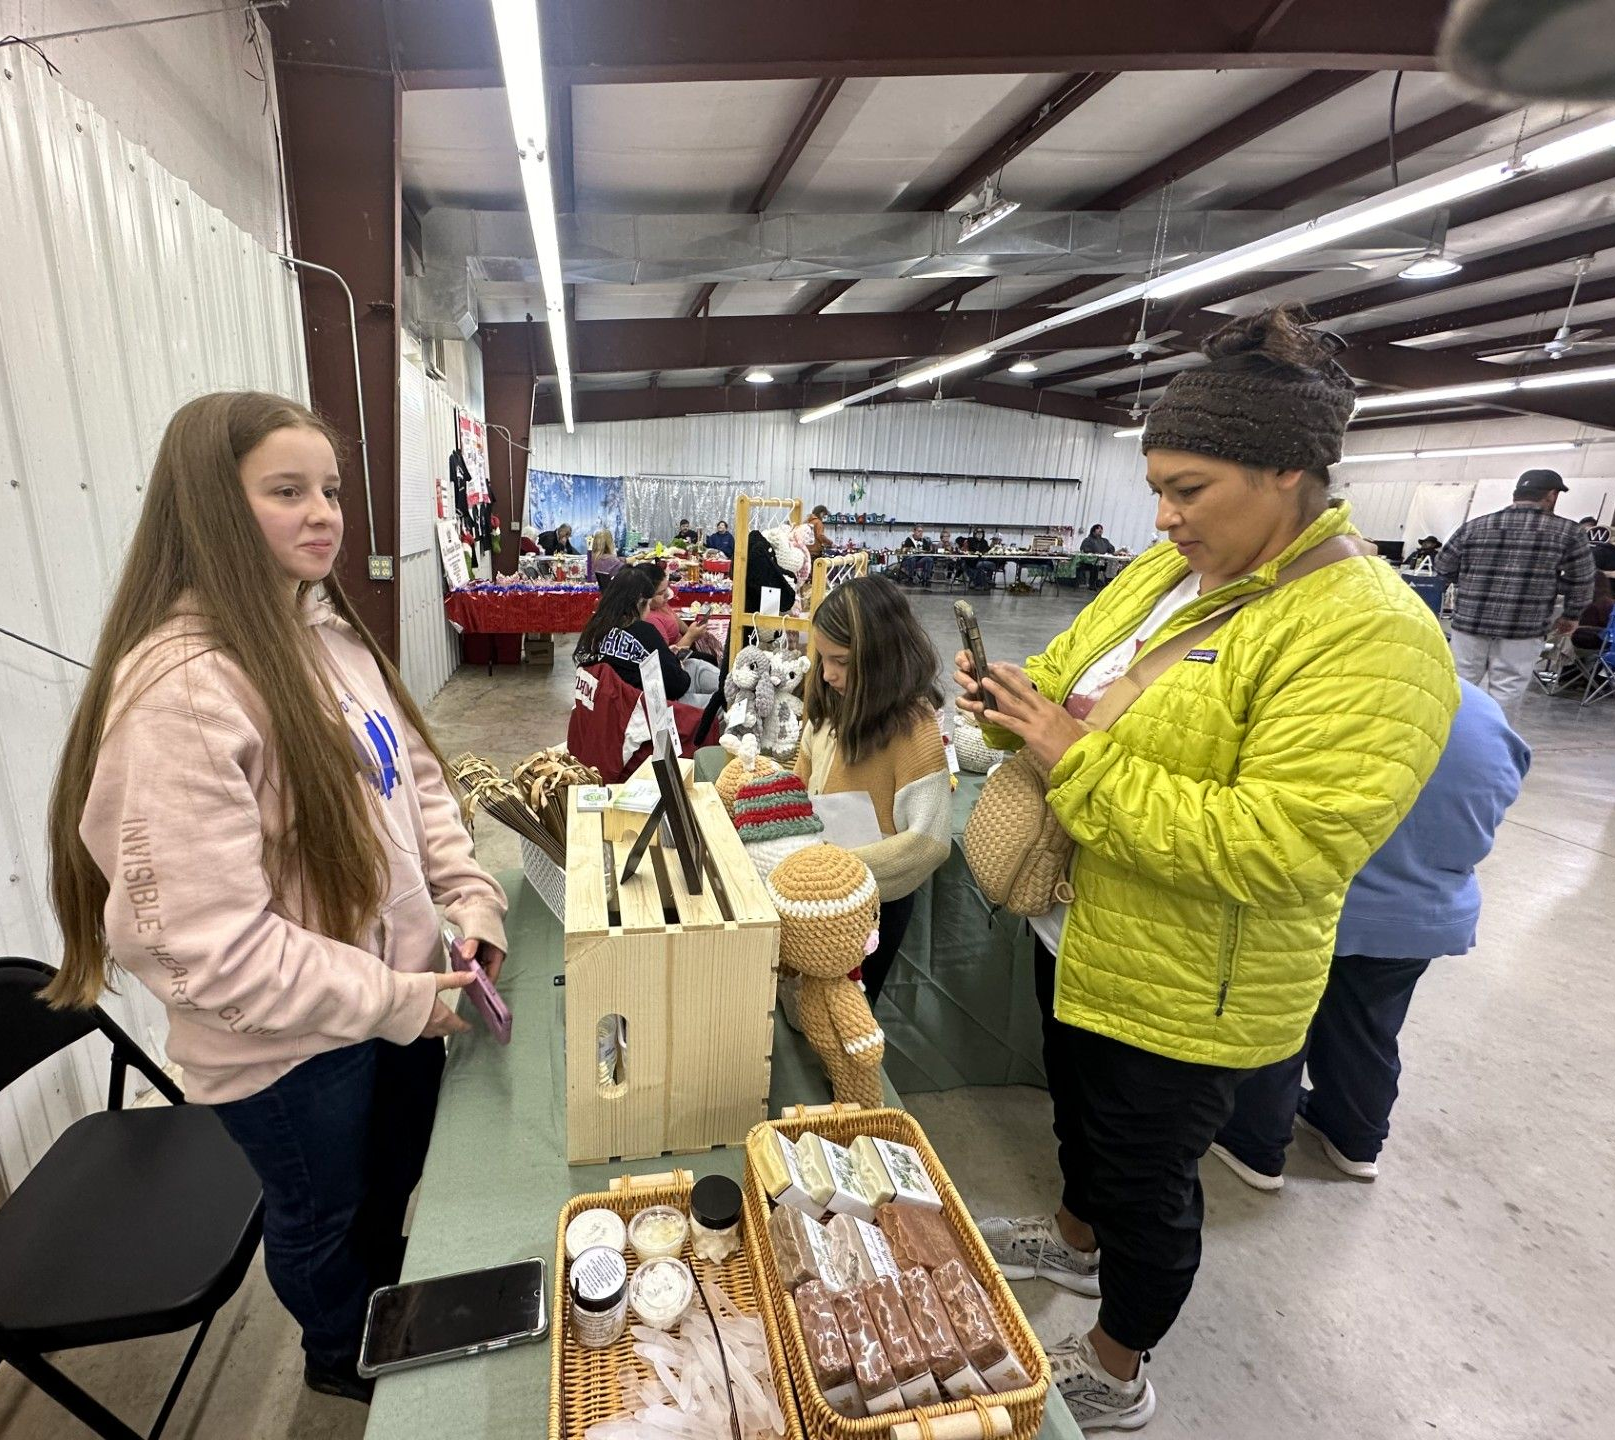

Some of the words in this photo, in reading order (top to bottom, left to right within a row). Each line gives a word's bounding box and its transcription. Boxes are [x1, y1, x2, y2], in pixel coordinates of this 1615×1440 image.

[599, 626, 651, 664] HEE
[121, 818, 163, 934] INVISIBLE
[145, 944, 198, 1011] HEART
